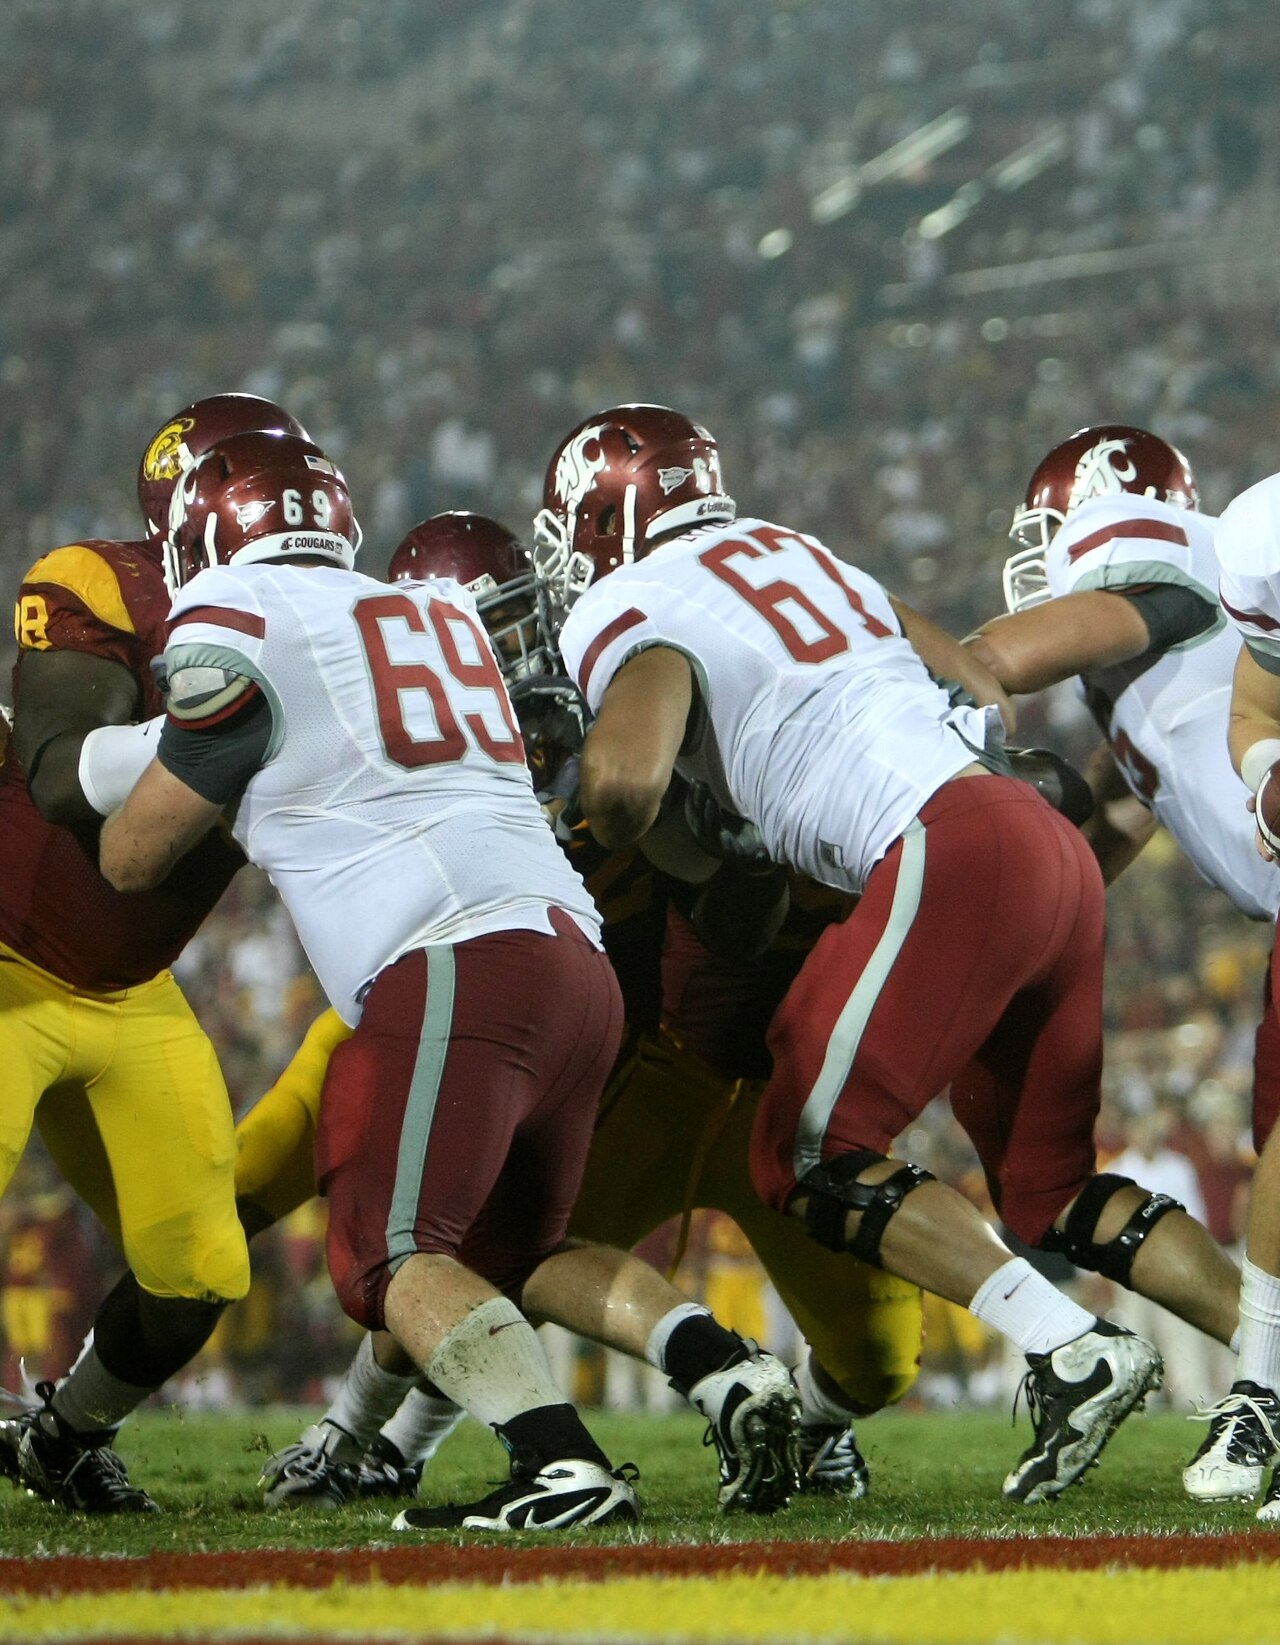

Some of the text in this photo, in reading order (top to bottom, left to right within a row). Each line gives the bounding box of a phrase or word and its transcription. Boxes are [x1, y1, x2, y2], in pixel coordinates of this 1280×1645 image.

[282, 488, 331, 527] 69
[294, 537, 334, 552] COUGARS
[14, 594, 53, 651] 8
[697, 526, 894, 665] 67
[351, 592, 526, 773] 69
